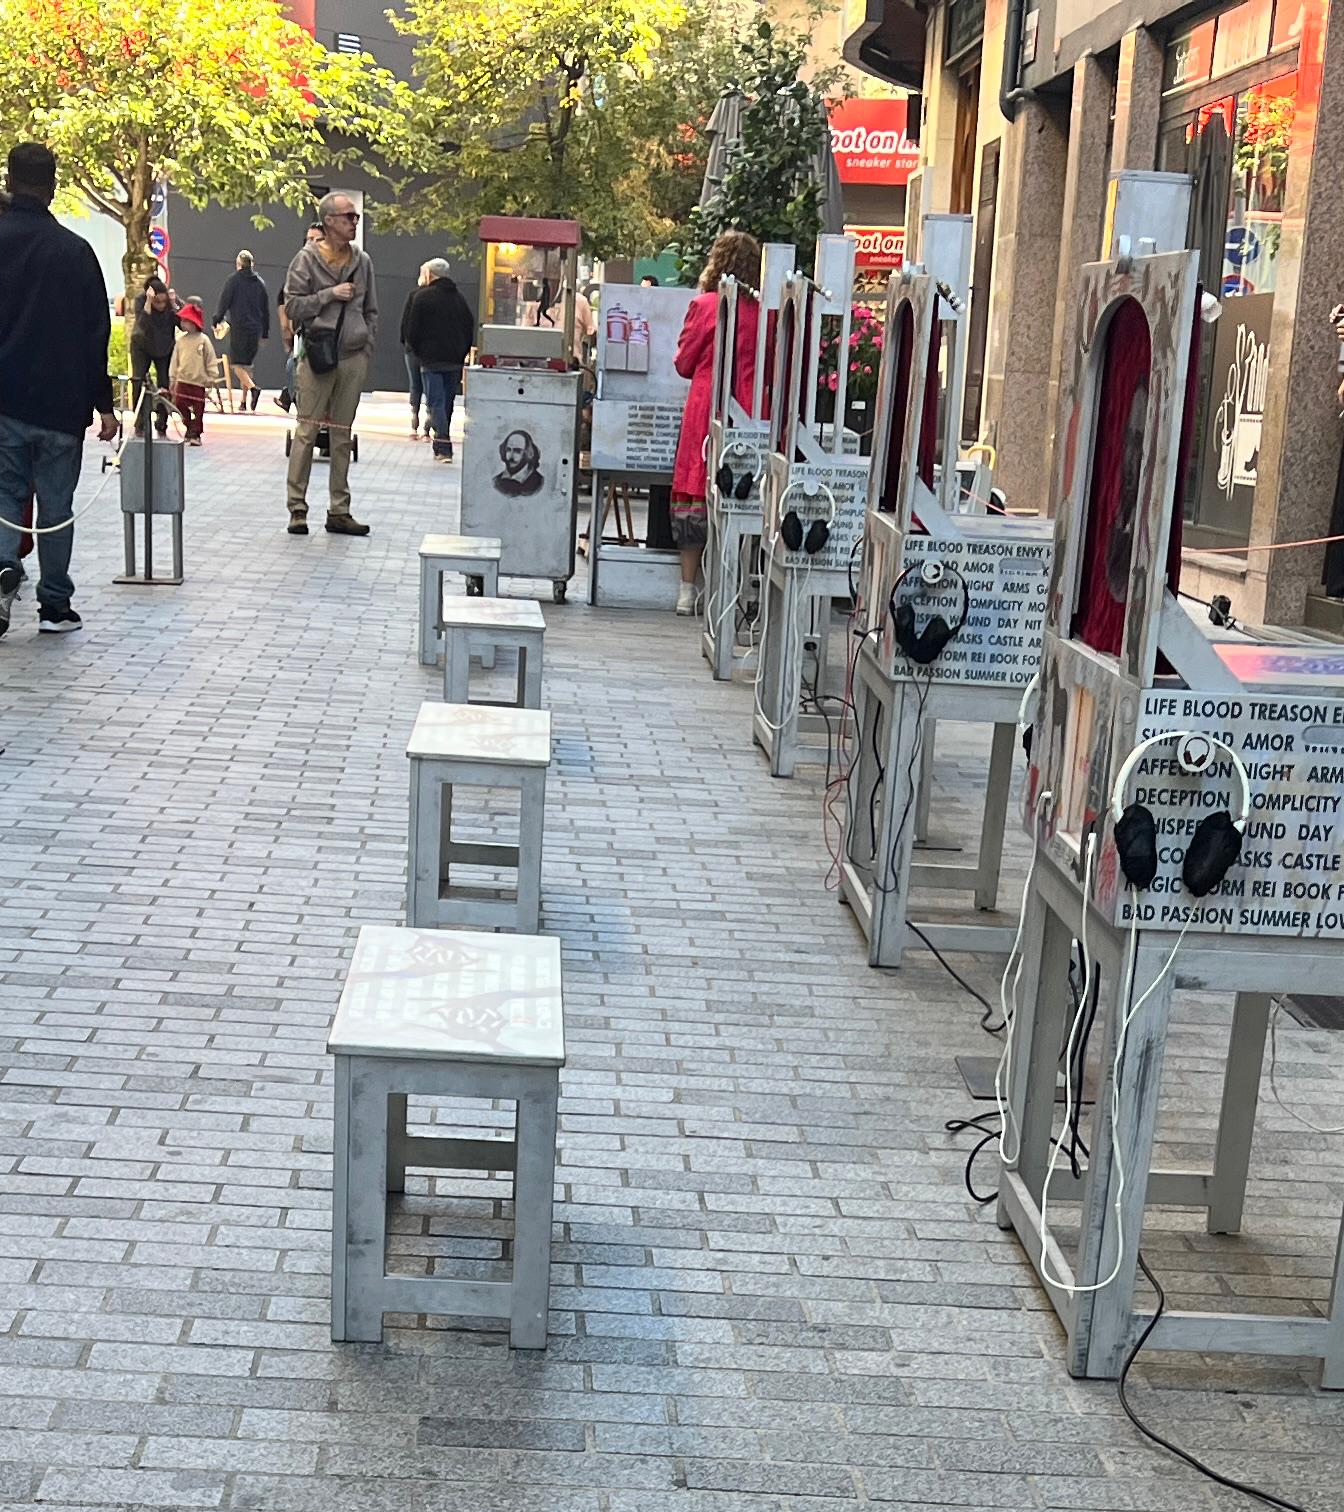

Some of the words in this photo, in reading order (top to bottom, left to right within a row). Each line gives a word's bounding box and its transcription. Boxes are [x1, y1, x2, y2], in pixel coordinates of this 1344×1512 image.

[867, 132, 898, 154] on
[846, 158, 892, 169] sneaker
[895, 158, 920, 169] stor
[884, 234, 904, 255] on
[791, 467, 805, 477] LIFE
[807, 468, 833, 478] BLOOD
[904, 539, 925, 552] LIFE
[927, 541, 963, 555] BLOOD
[967, 543, 1014, 559] TREASON
[1017, 546, 1045, 560] ENVY
[963, 561, 995, 575] AMOR
[1002, 582, 1031, 596] ARMS
[967, 598, 1023, 613] OMPLICITY
[997, 616, 1019, 630] DAY
[1024, 618, 1042, 631] NIT
[987, 635, 1024, 648] CASTLE
[970, 650, 986, 664] REI
[989, 652, 1019, 666] BOOK
[893, 664, 915, 678] BAD
[915, 665, 961, 680] PASSION
[963, 667, 1007, 683] SUMMER
[1144, 698, 1178, 716] LIFE
[1182, 699, 1243, 720] BLOOD
[1248, 702, 1328, 724] TREASON
[1241, 732, 1296, 752] AMOR
[1135, 787, 1232, 809] DECEPTION
[1250, 794, 1343, 813] OMPLICITY
[1297, 823, 1335, 843] DAY
[1281, 852, 1342, 871] CASTLE
[1251, 880, 1276, 899] REI
[1282, 882, 1335, 901] BOOK
[1121, 904, 1156, 922] BAD
[1160, 905, 1234, 926] PASSION
[1239, 909, 1312, 930] SUMMER
